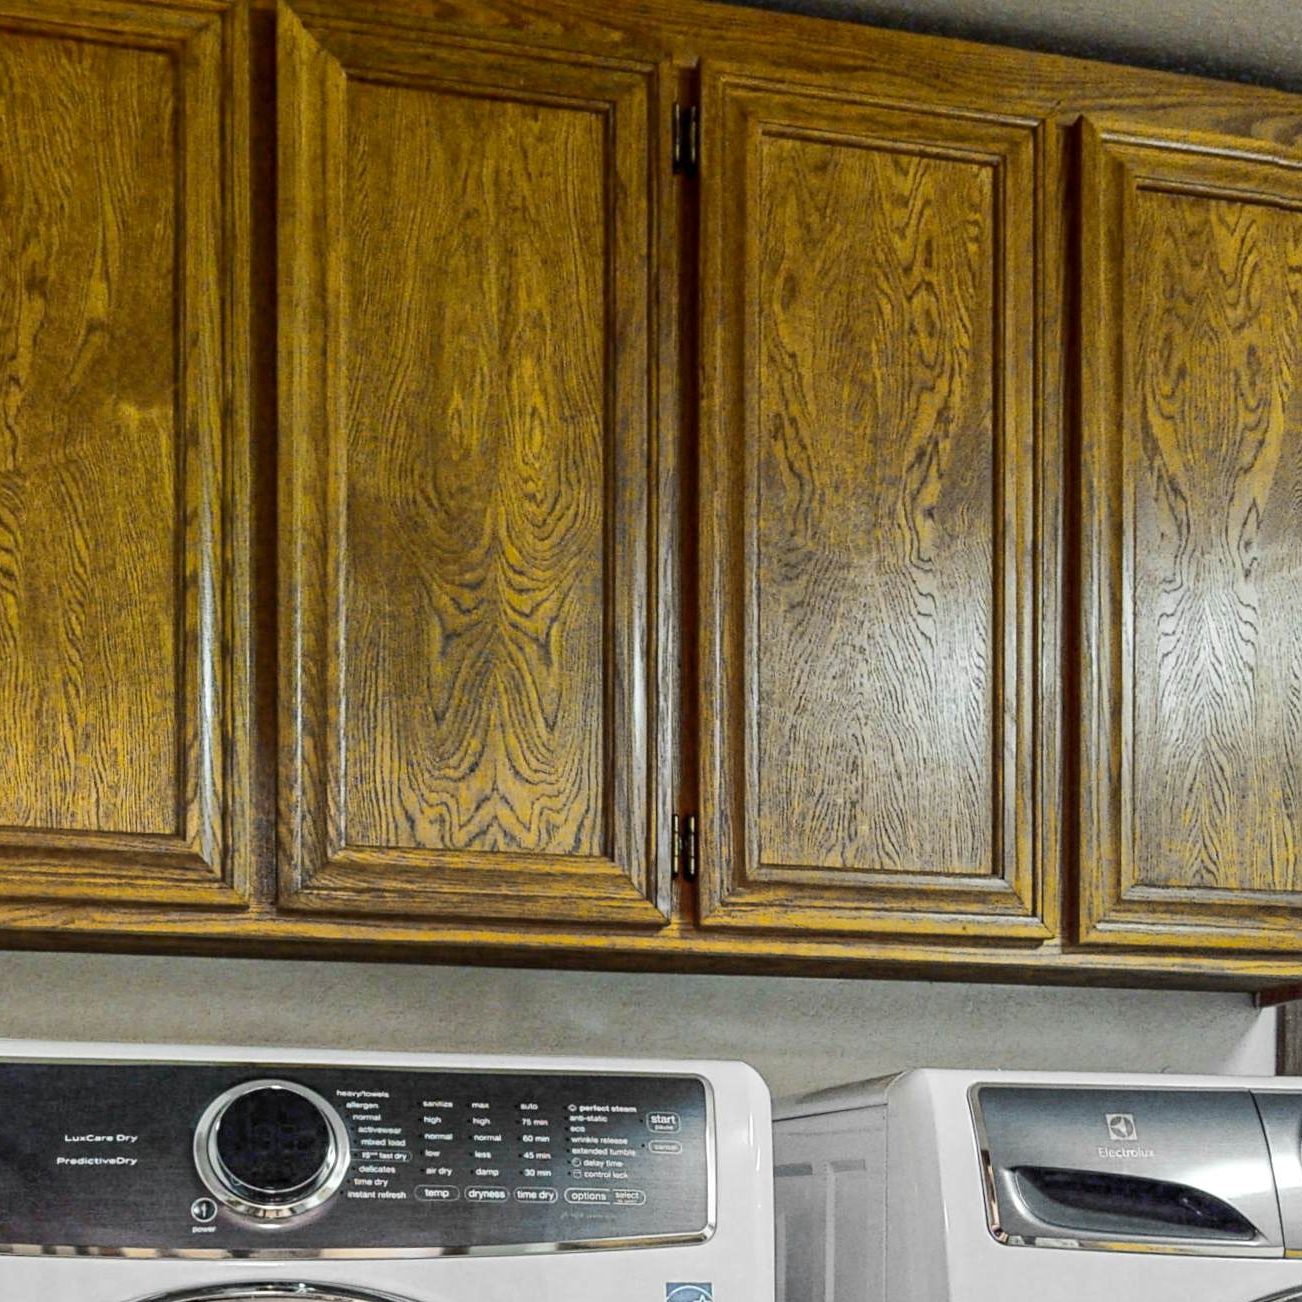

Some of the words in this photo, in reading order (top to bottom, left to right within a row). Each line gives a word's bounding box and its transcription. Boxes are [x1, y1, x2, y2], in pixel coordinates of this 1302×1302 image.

[579, 1105, 610, 1113] perfect
[424, 1115, 442, 1125] high
[472, 1117, 491, 1126] high
[650, 1115, 676, 1125] start
[358, 1126, 402, 1134] activewear
[64, 1134, 114, 1142] LuxCare
[116, 1134, 138, 1143] Dry
[474, 1134, 502, 1142] normal
[571, 1136, 599, 1144] wrinkle
[600, 1137, 628, 1145] release
[425, 1149, 441, 1157] low
[474, 1150, 492, 1159] less
[523, 1151, 535, 1159] 45
[571, 1148, 608, 1156] extended
[1098, 1147, 1155, 1158] Electrolux
[56, 1156, 138, 1166] PredictiveDry
[394, 1152, 407, 1162] dry
[583, 1159, 604, 1169] delay
[606, 1159, 623, 1168] time
[358, 1165, 396, 1174] delicates
[426, 1167, 437, 1175] air
[438, 1167, 453, 1176] dry
[475, 1168, 499, 1177] damp
[584, 1171, 612, 1179] control
[613, 1171, 629, 1179] lock
[354, 1178, 373, 1186] time
[374, 1178, 389, 1188] dry
[347, 1191, 376, 1199] instant
[377, 1191, 407, 1199] refresh
[424, 1188, 450, 1198] temp
[468, 1189, 506, 1200] dryness
[516, 1190, 537, 1199] time
[538, 1190, 554, 1201] dry
[571, 1192, 607, 1201] options
[615, 1190, 640, 1199] select
